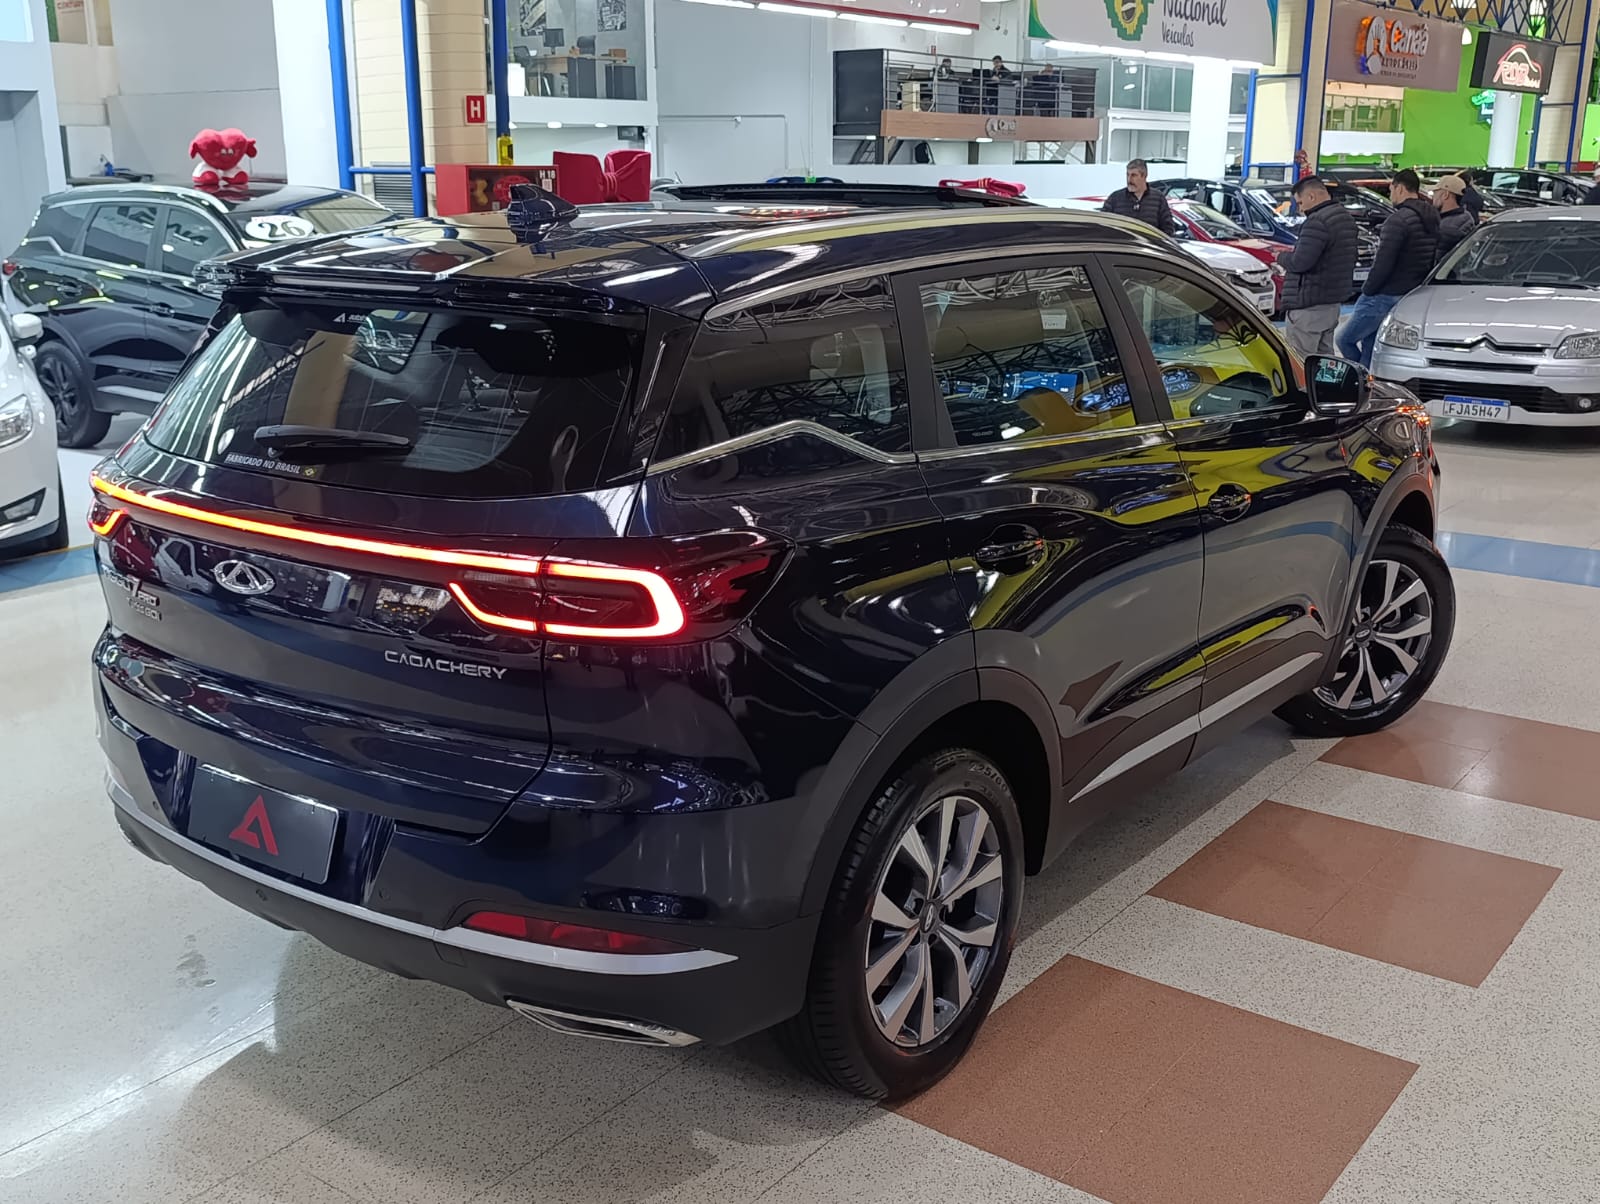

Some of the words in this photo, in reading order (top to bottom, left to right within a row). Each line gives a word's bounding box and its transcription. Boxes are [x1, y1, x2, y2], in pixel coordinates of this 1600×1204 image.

[470, 100, 481, 119] H
[257, 220, 306, 238] 26
[1448, 402, 1502, 419] FJA5H47
[223, 453, 263, 467] FABRICADO
[262, 459, 276, 469] NO
[274, 462, 301, 474] BRASIL
